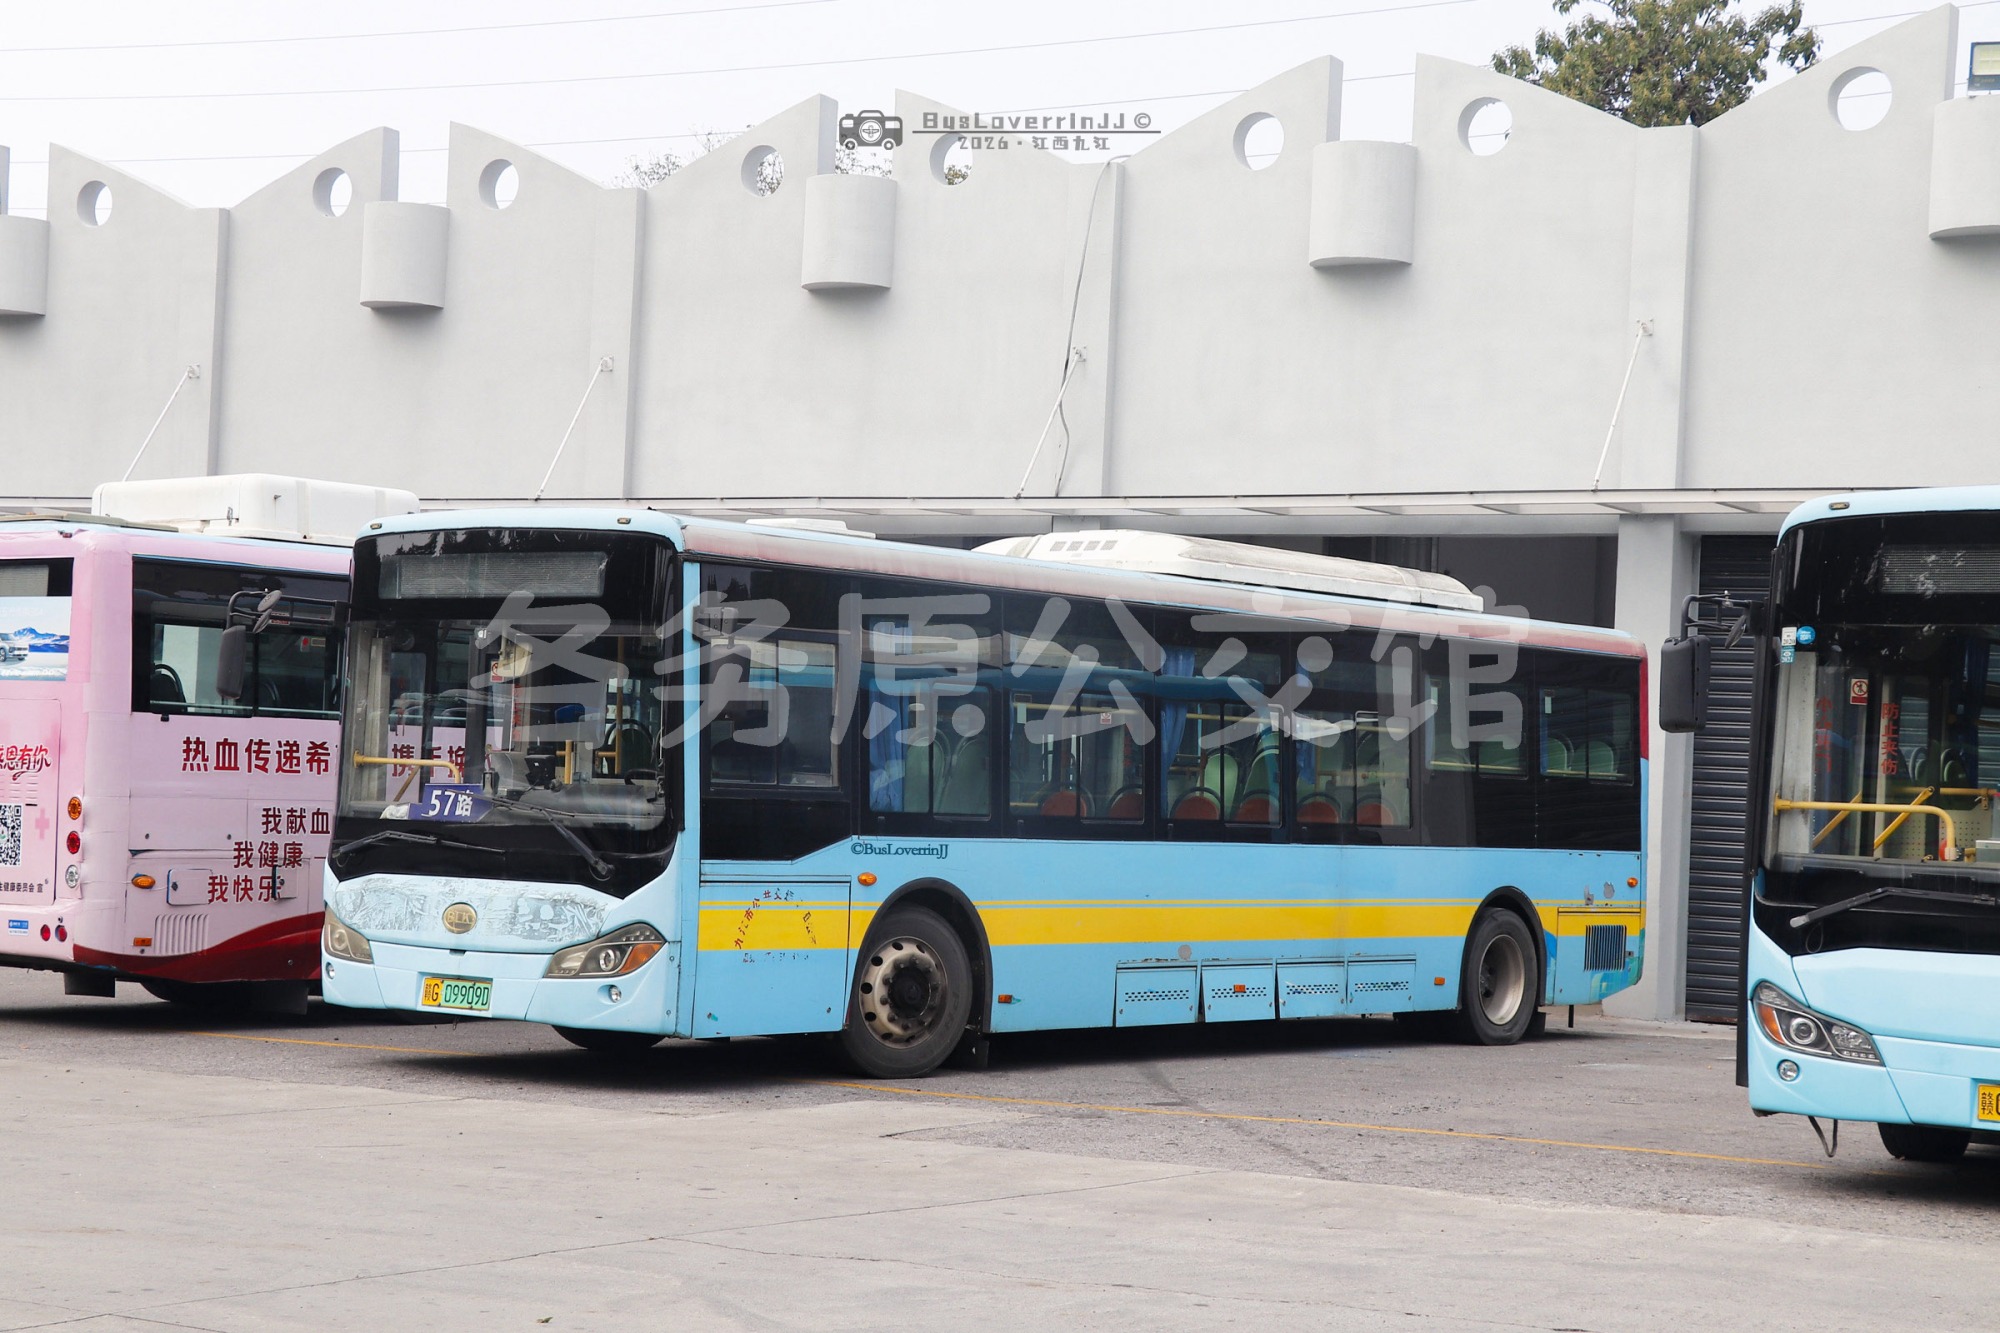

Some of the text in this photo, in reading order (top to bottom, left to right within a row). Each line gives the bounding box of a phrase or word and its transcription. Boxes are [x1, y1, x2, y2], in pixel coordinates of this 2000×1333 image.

[1881, 703, 1899, 775] 防止夹伤
[181, 736, 331, 775] 热血传递希
[428, 789, 473, 817] 57路
[261, 806, 330, 834] 我献血
[233, 840, 303, 868] 我健康
[207, 875, 283, 903] 我快乐
